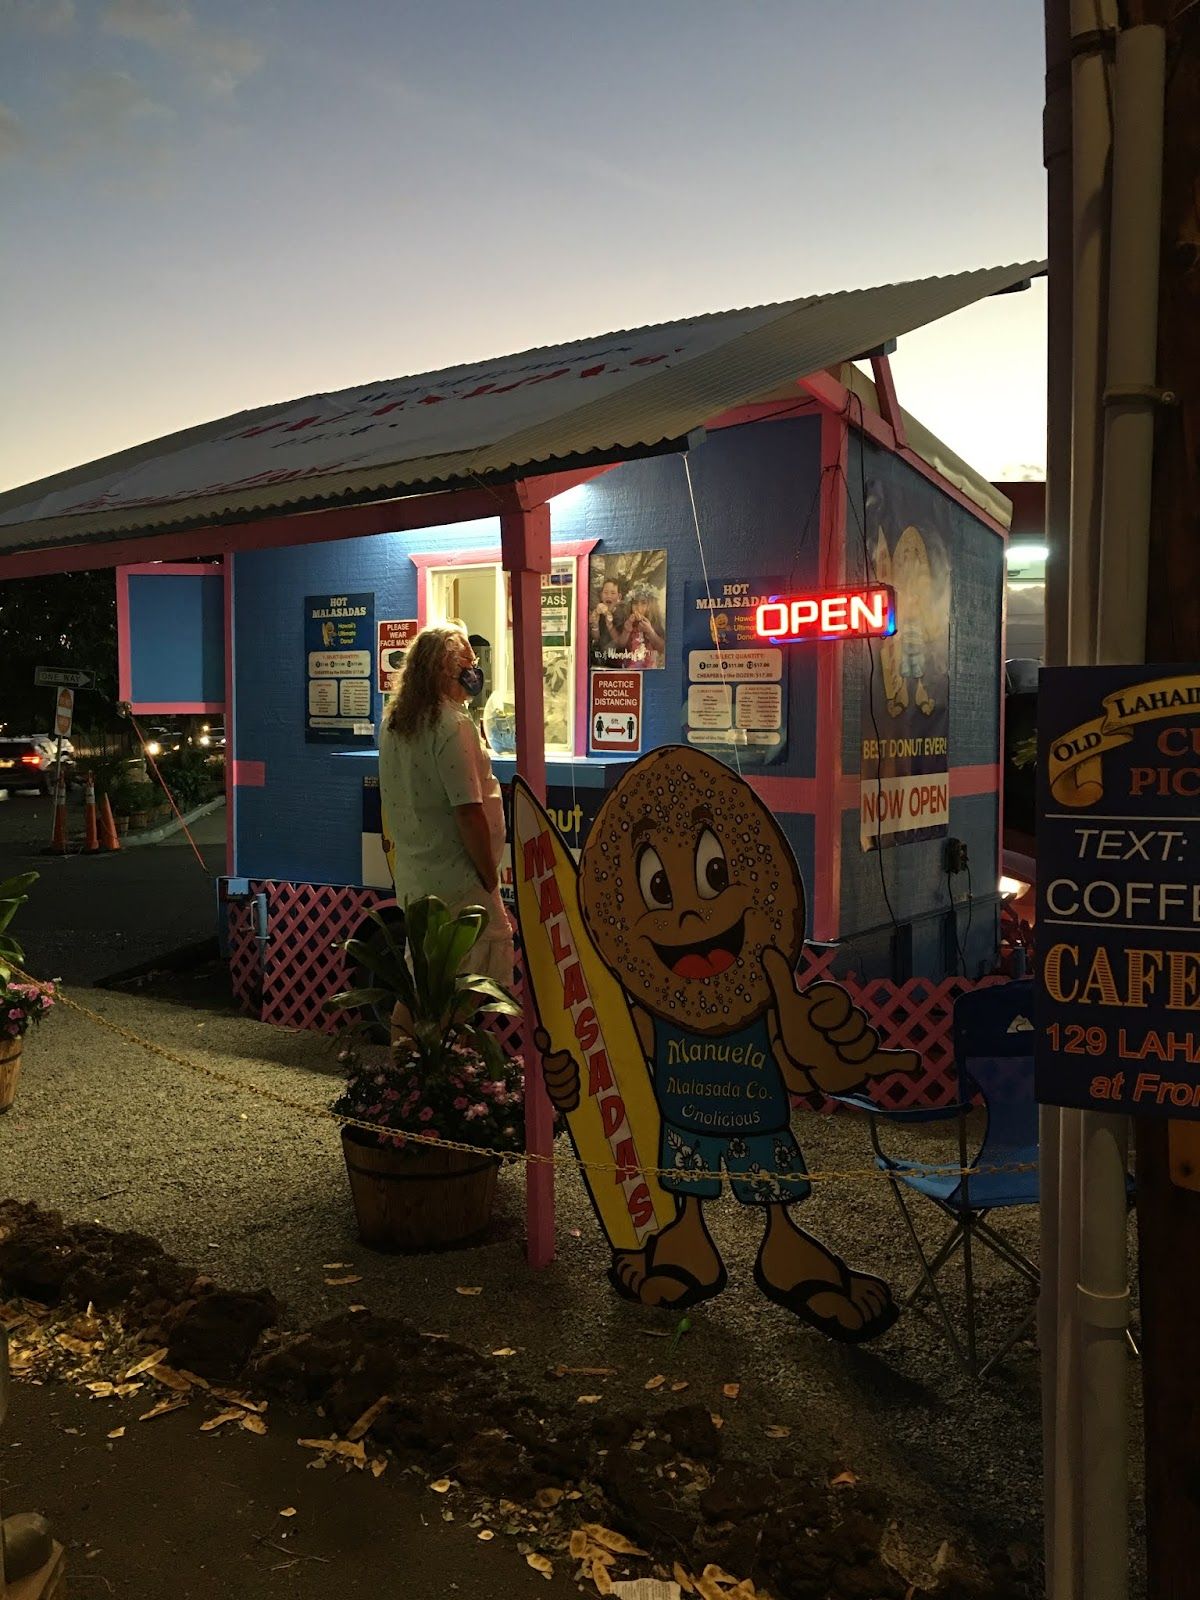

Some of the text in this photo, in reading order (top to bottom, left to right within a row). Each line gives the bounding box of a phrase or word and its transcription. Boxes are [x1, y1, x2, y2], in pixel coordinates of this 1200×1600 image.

[541, 595, 567, 606] PASS
[723, 584, 749, 595] HOT
[312, 606, 367, 618] MALASADAS
[330, 597, 348, 606] HOT
[696, 596, 768, 609] MALASADA
[756, 594, 884, 636] OPEN
[386, 623, 410, 631] PLEASE
[389, 631, 407, 639] WEAR
[599, 680, 635, 689] PRACTICE
[603, 689, 630, 697] SOCIAL
[595, 698, 638, 706] DISTANCING
[863, 737, 947, 759] BEST DONUT EVER!
[1053, 732, 1102, 762] OLD
[1157, 727, 1200, 757] C
[863, 784, 947, 823] NOW OPEN
[1074, 829, 1188, 861] TEXT:
[1045, 878, 1200, 923] COFF
[1044, 943, 1200, 1010] CAFE
[524, 830, 658, 1229] MALASADAS
[668, 1039, 766, 1070] Manuela
[1046, 1023, 1200, 1063] 129 LAH
[666, 1077, 773, 1100] Malasada Co.
[1089, 1072, 1125, 1100] at
[681, 1104, 761, 1127] Onolicious
